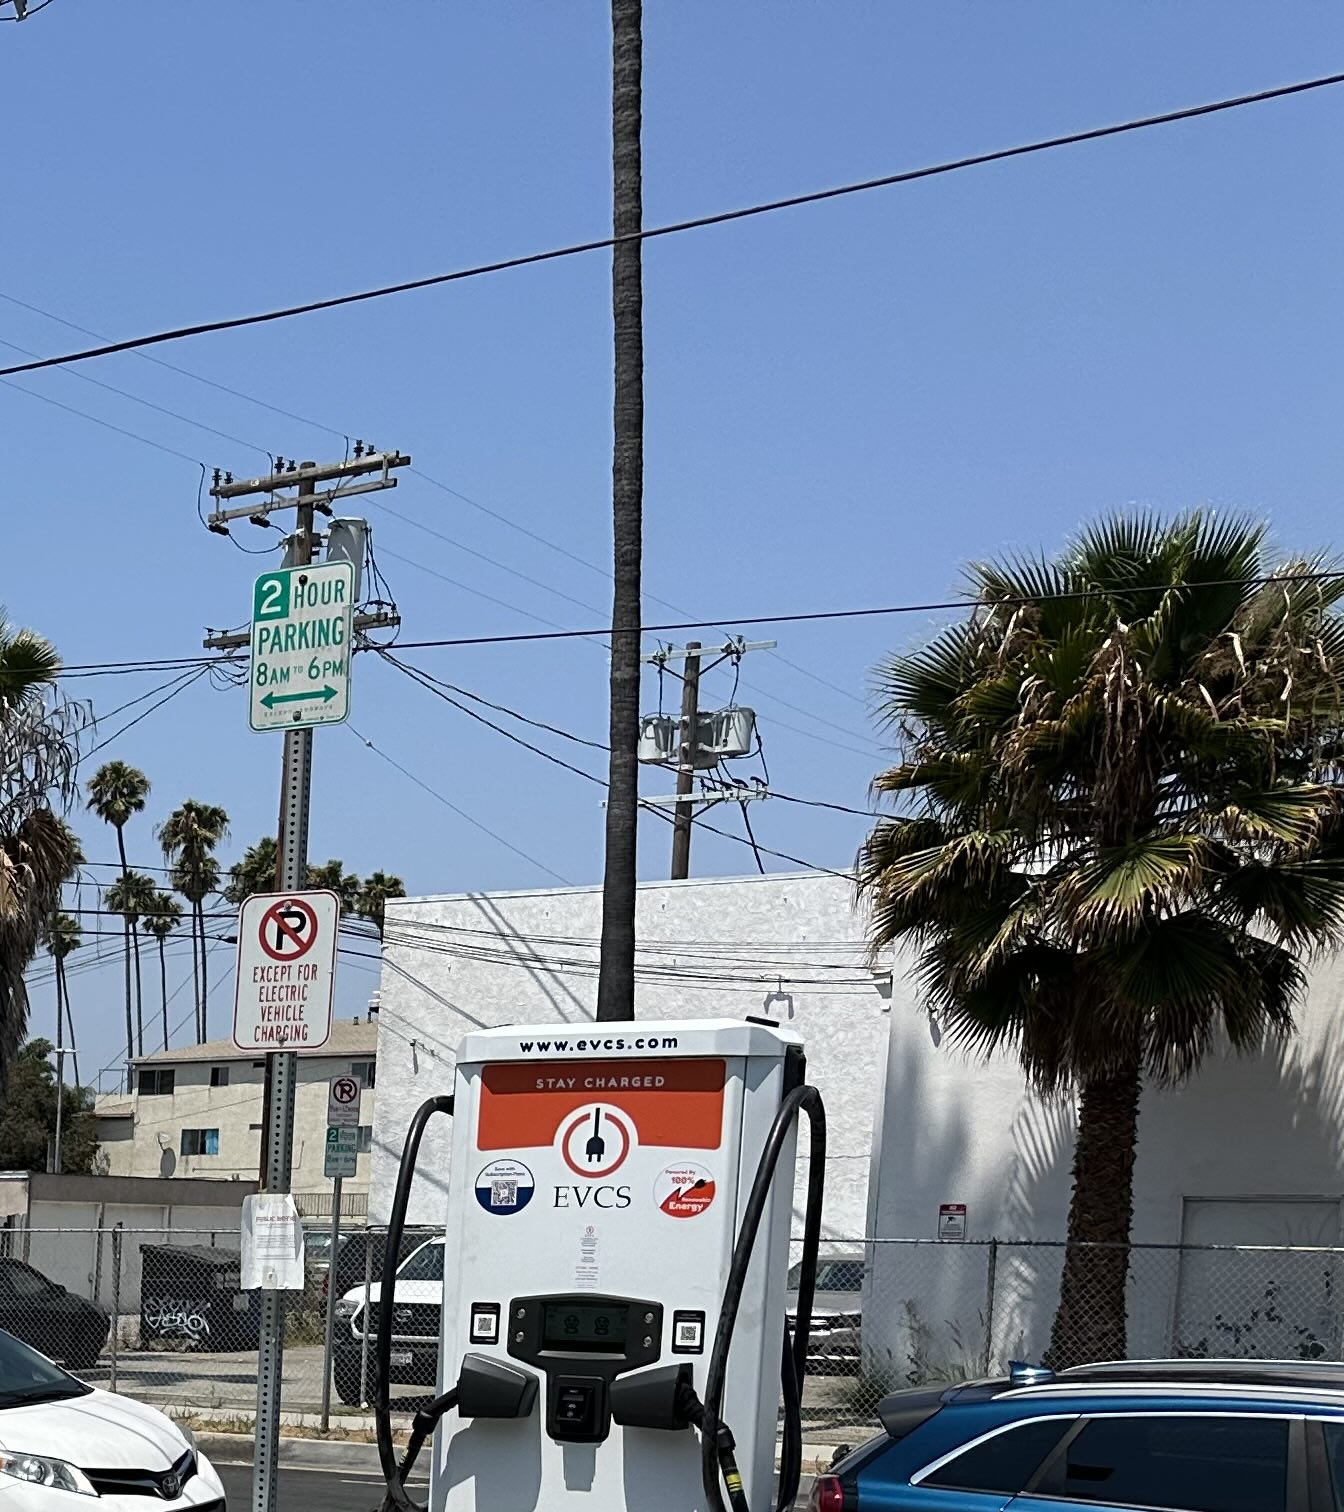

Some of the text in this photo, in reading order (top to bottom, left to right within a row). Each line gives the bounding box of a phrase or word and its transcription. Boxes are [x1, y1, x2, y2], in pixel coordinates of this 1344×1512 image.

[260, 579, 345, 615] 2 HOUR
[258, 616, 344, 656] PARKING
[256, 662, 290, 687] 8AM
[307, 656, 344, 680] 6PM
[252, 963, 318, 984] EXCEPT FOR
[259, 984, 308, 1003] ELECTRIC
[260, 1004, 305, 1022] VEHICLE
[254, 1024, 308, 1042] CHARGING
[519, 1036, 679, 1053] www.evcs.com
[535, 1075, 666, 1090] STAY CHARGED
[328, 1129, 337, 1141] 2
[553, 1185, 632, 1209] EVCS
[668, 1201, 704, 1213] Energy
